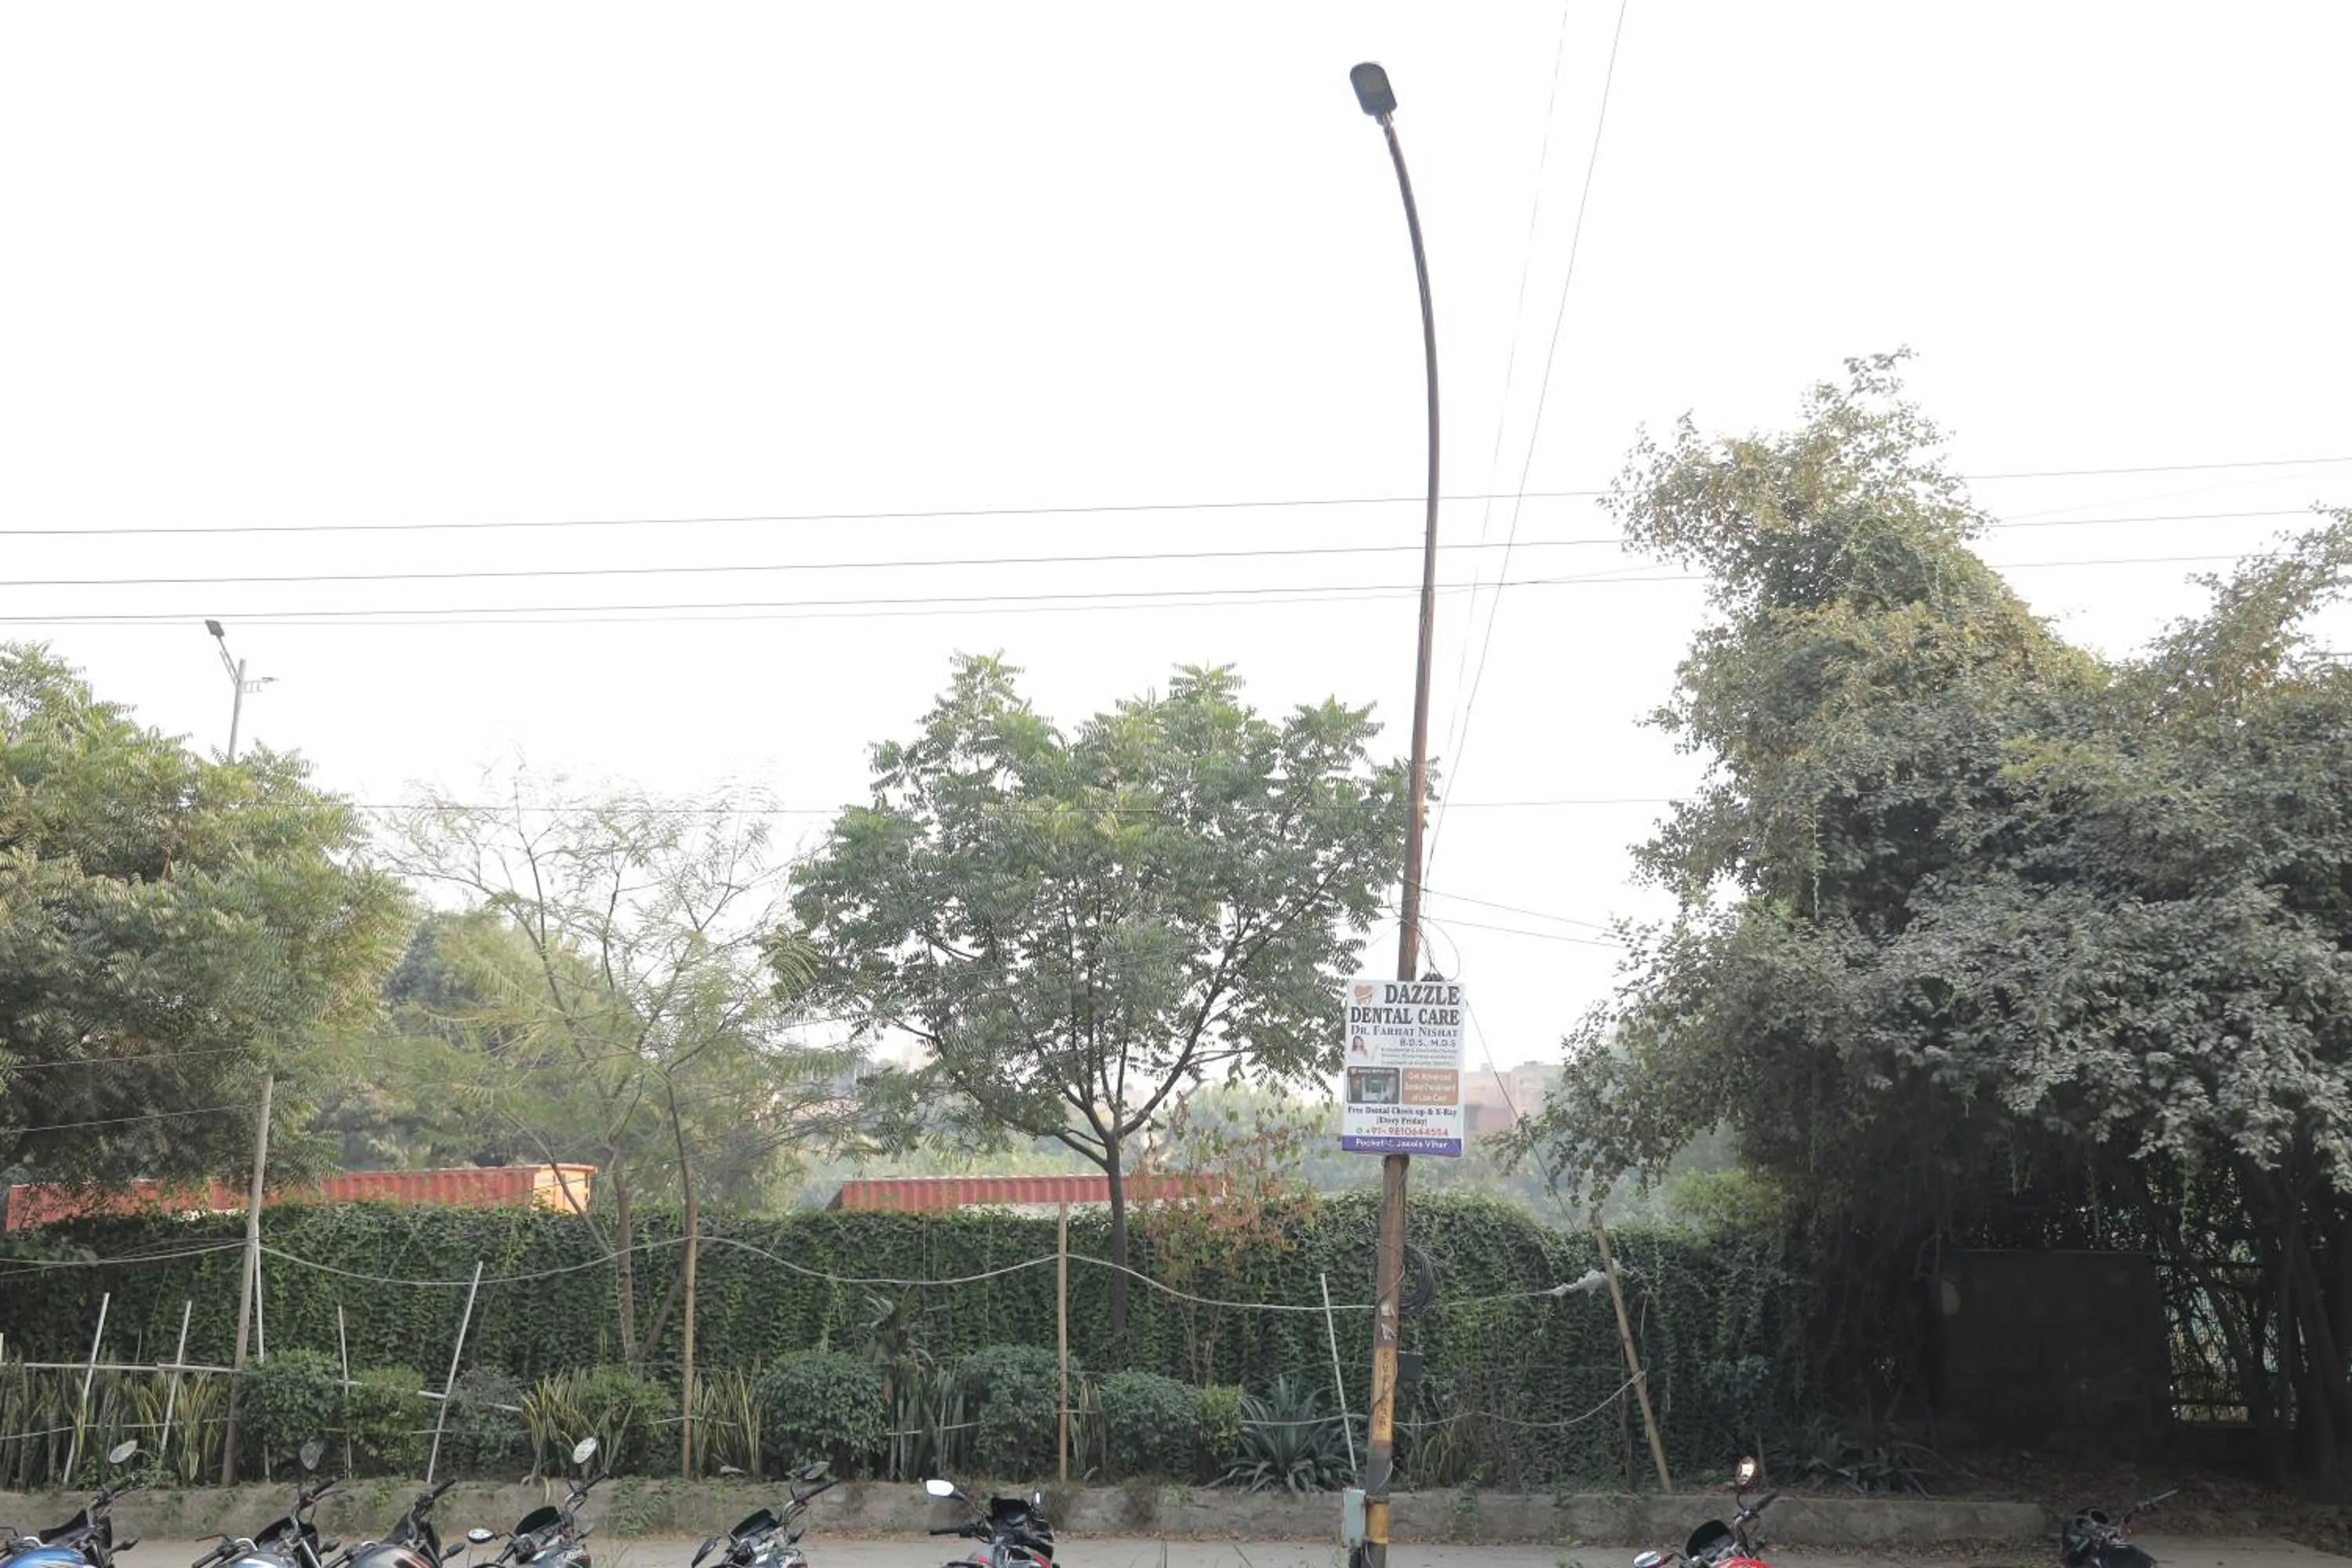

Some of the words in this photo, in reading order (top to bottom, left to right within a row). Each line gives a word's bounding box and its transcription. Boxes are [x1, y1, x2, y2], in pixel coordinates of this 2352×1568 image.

[1385, 985, 1460, 1005] DAZZLE
[1350, 1007, 1413, 1024] DENTAL
[1418, 1009, 1460, 1025] CARE
